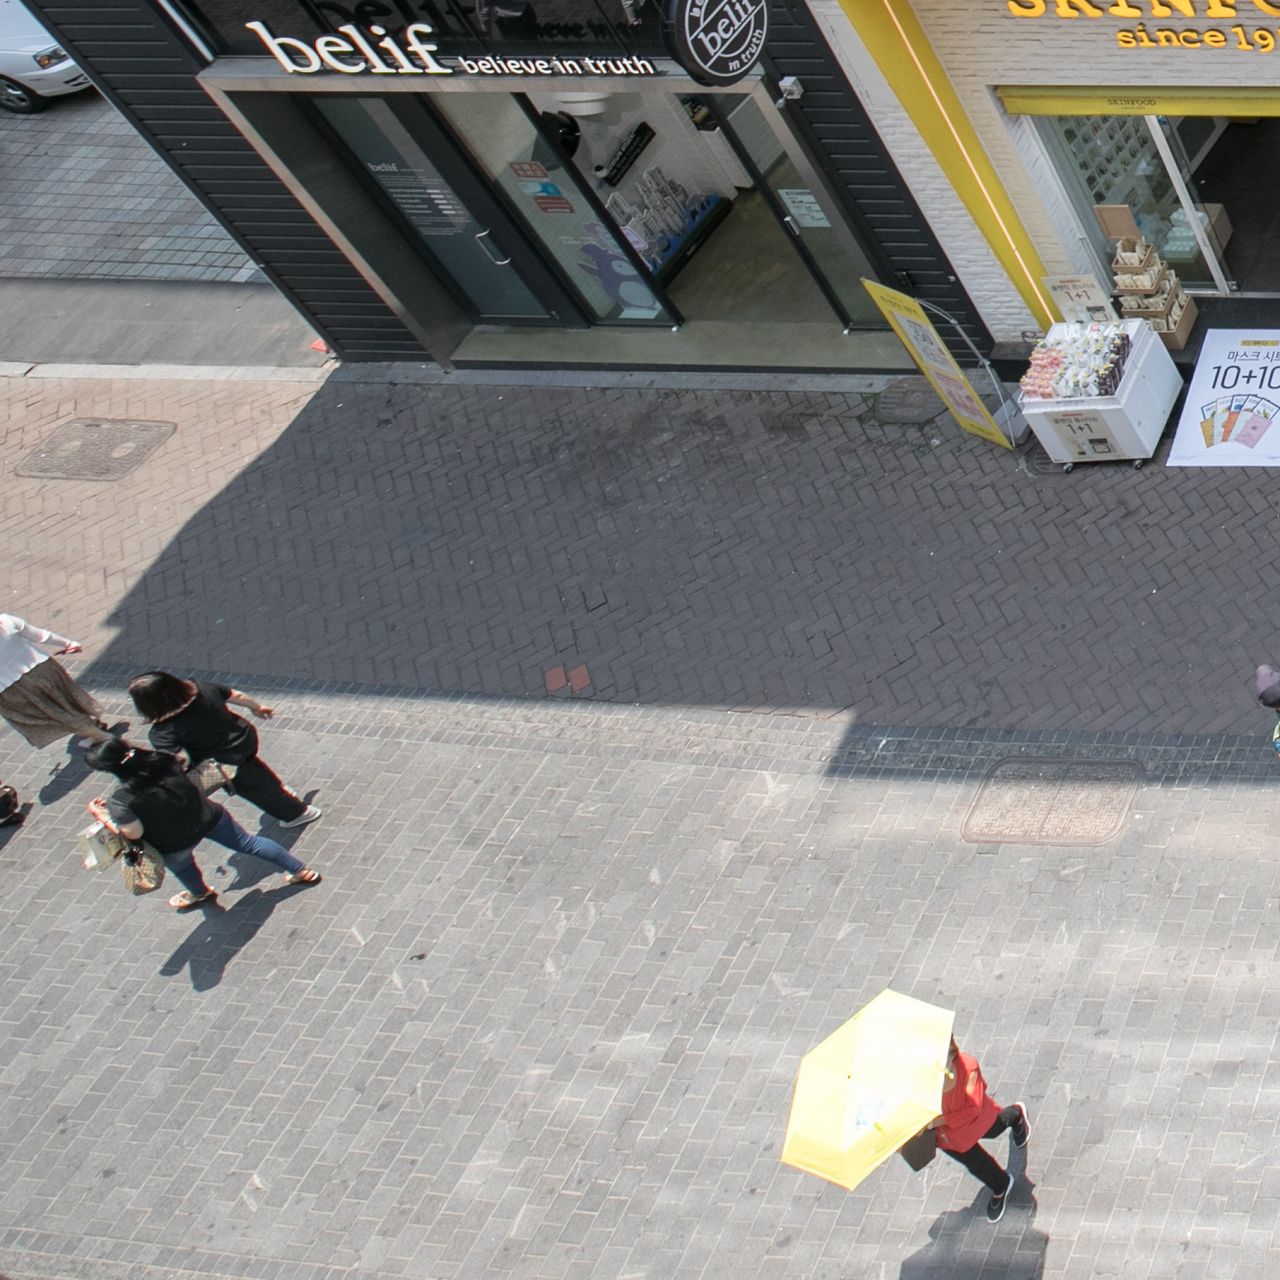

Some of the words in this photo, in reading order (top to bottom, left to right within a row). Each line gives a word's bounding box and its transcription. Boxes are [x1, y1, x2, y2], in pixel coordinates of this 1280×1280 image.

[1117, 25, 1227, 49] since
[245, 21, 453, 75] belif
[458, 56, 551, 75] believe
[553, 54, 582, 74] in
[585, 56, 655, 75] truth
[728, 60, 741, 71] in
[741, 29, 763, 63] truth
[1107, 98, 1157, 107] SKINFOOD
[367, 162, 398, 172] belif
[1227, 351, 1261, 362] 마스크
